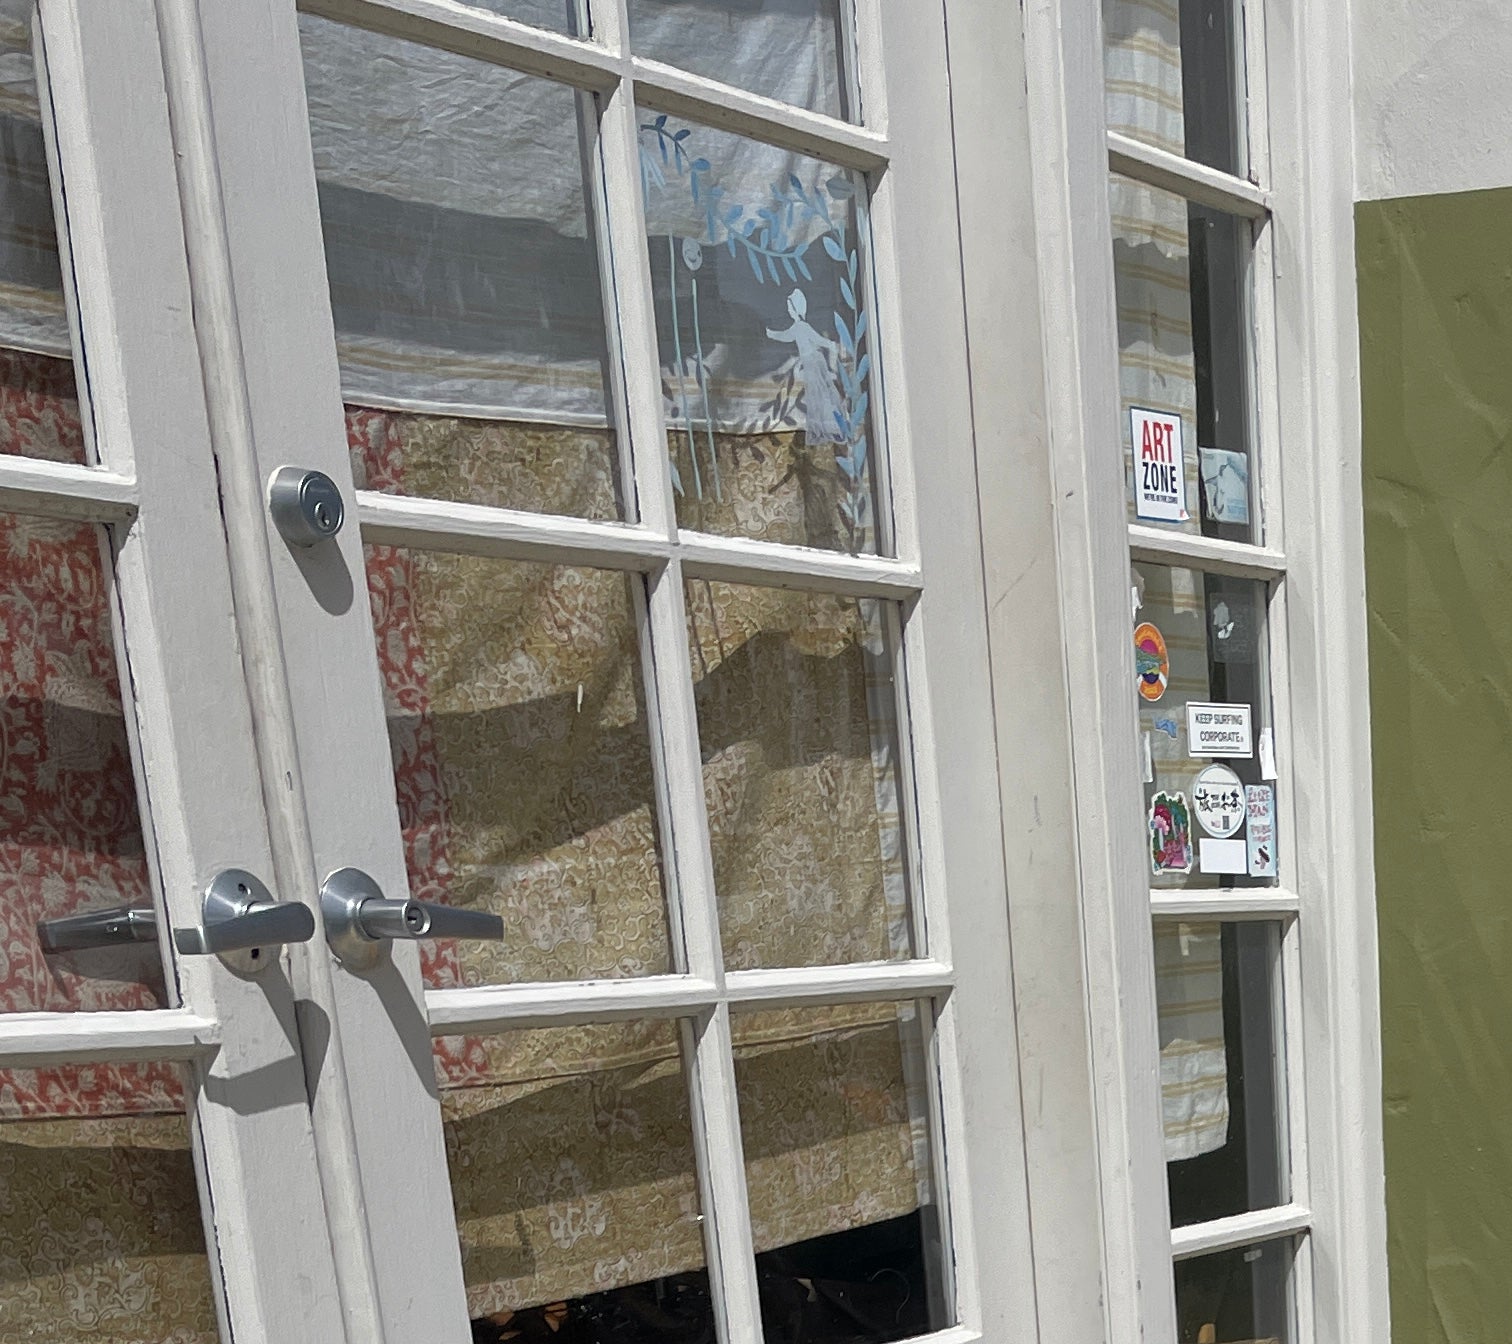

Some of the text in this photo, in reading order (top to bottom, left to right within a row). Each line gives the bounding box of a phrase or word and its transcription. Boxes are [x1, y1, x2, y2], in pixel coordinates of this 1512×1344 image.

[1141, 420, 1174, 463] ART
[1142, 462, 1178, 494] ZONE
[1195, 713, 1243, 726] KEEP SURFING
